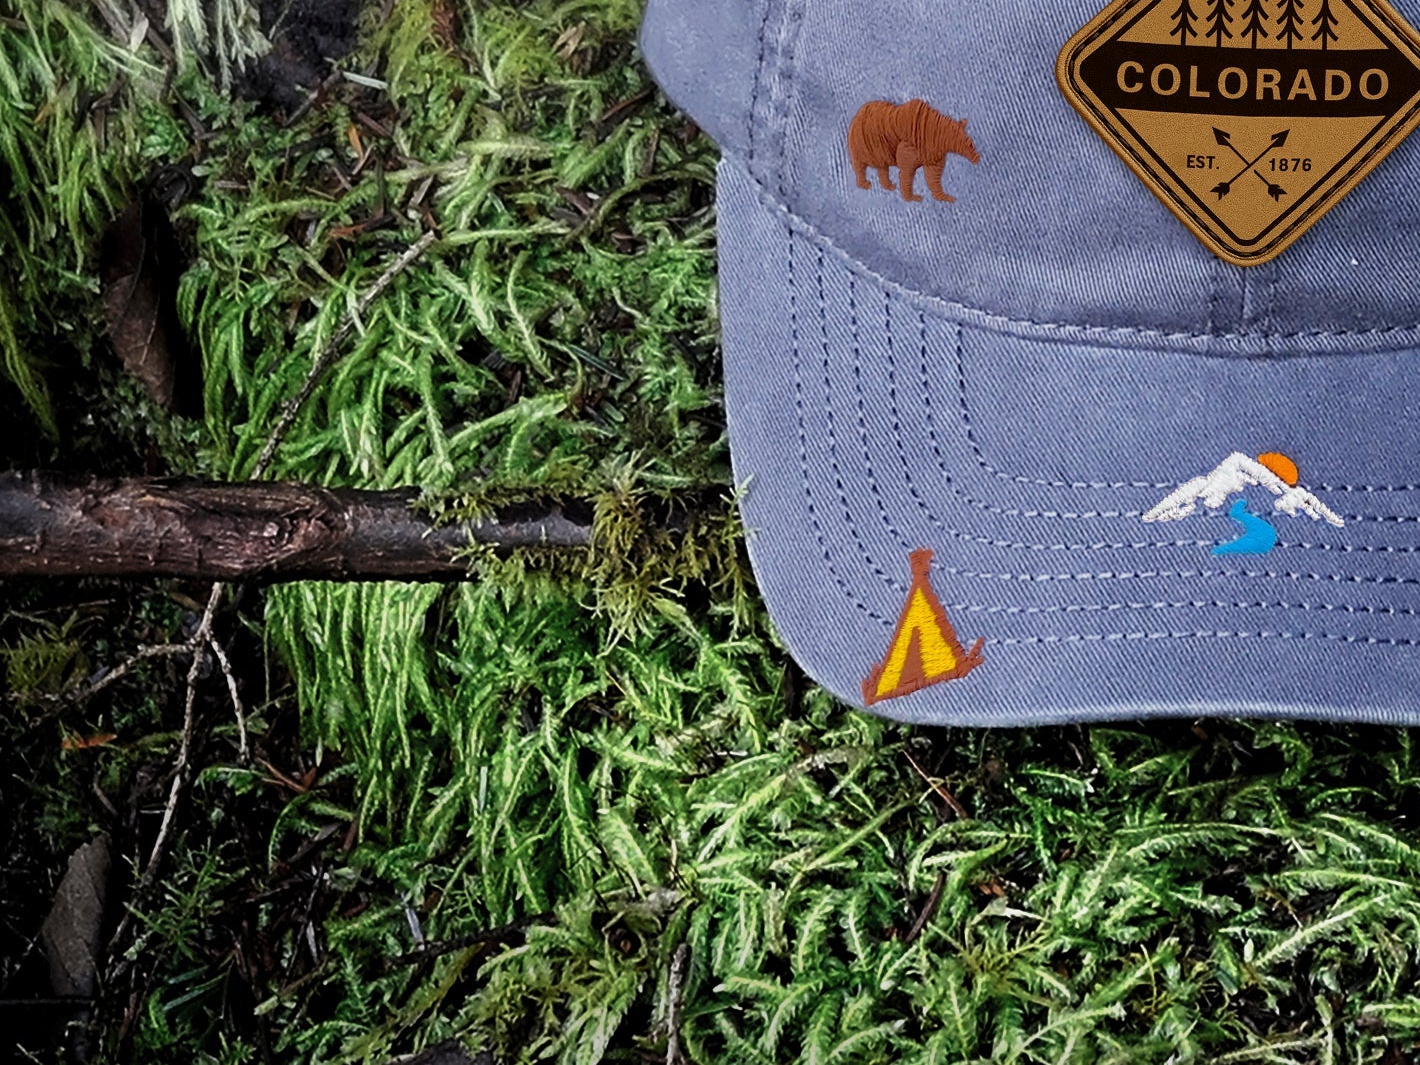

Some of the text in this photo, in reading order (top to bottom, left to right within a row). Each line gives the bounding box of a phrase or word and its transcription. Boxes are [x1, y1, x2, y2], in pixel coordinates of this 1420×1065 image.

[1116, 60, 1389, 102] COLORADO
[1186, 154, 1312, 172] EST. 1876
